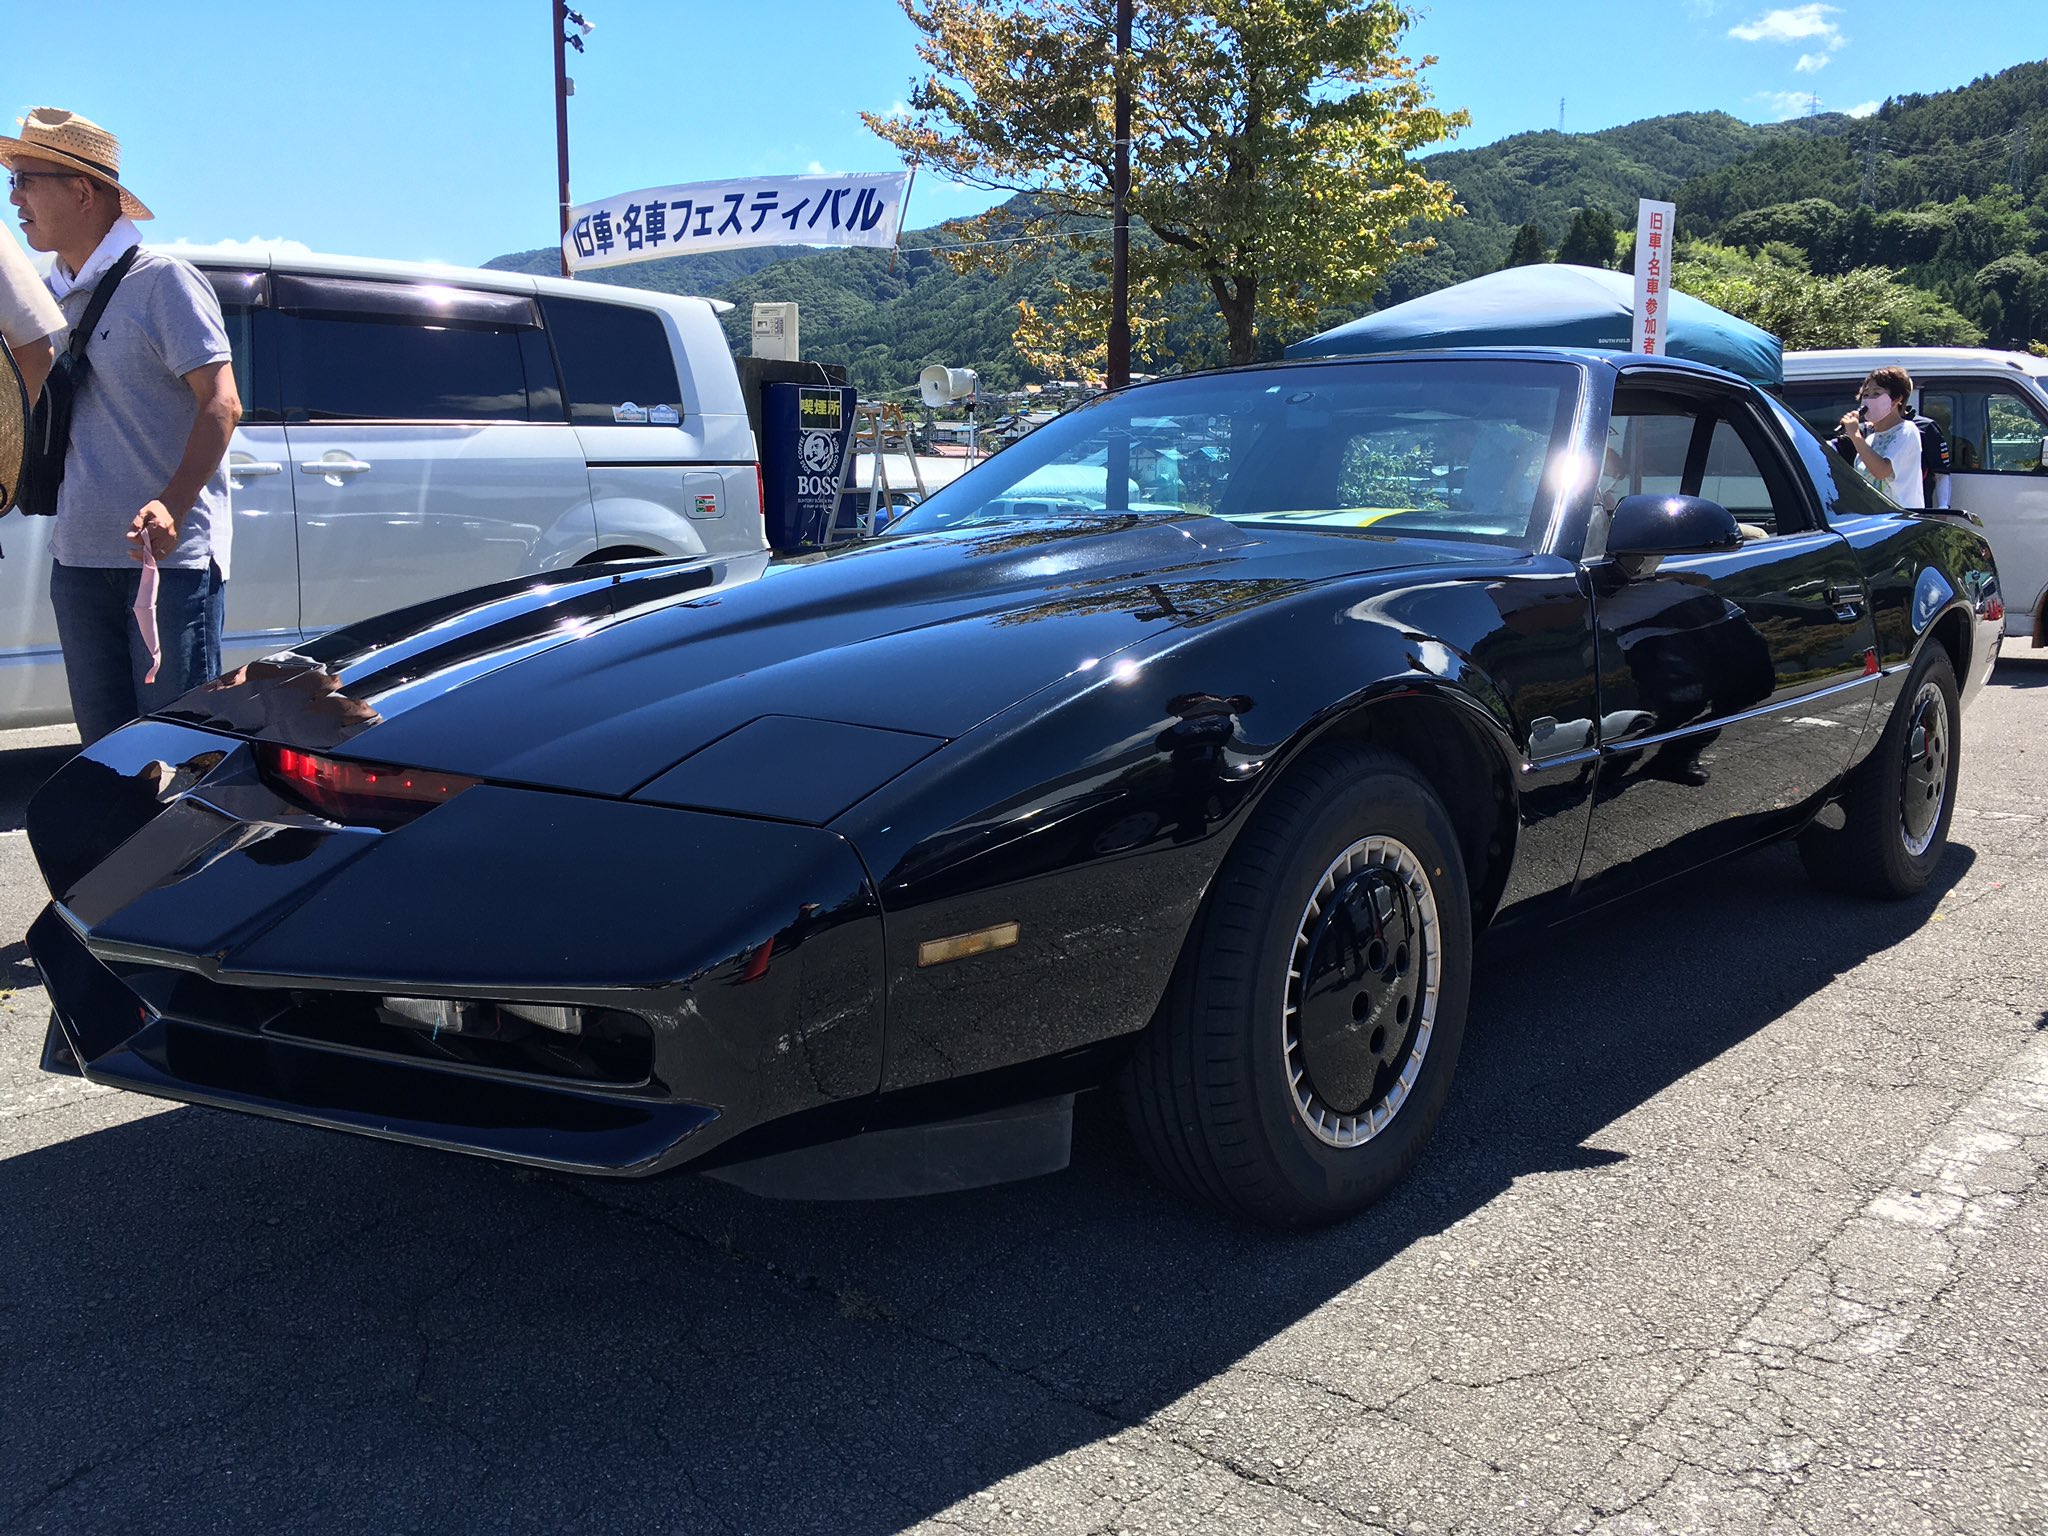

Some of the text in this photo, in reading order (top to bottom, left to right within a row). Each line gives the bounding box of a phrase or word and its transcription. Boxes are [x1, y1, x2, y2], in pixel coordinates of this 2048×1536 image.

[572, 187, 885, 258] 旧車・名車フェスティバル
[800, 398, 840, 416] 喫煙所
[797, 475, 840, 495] BOSS
